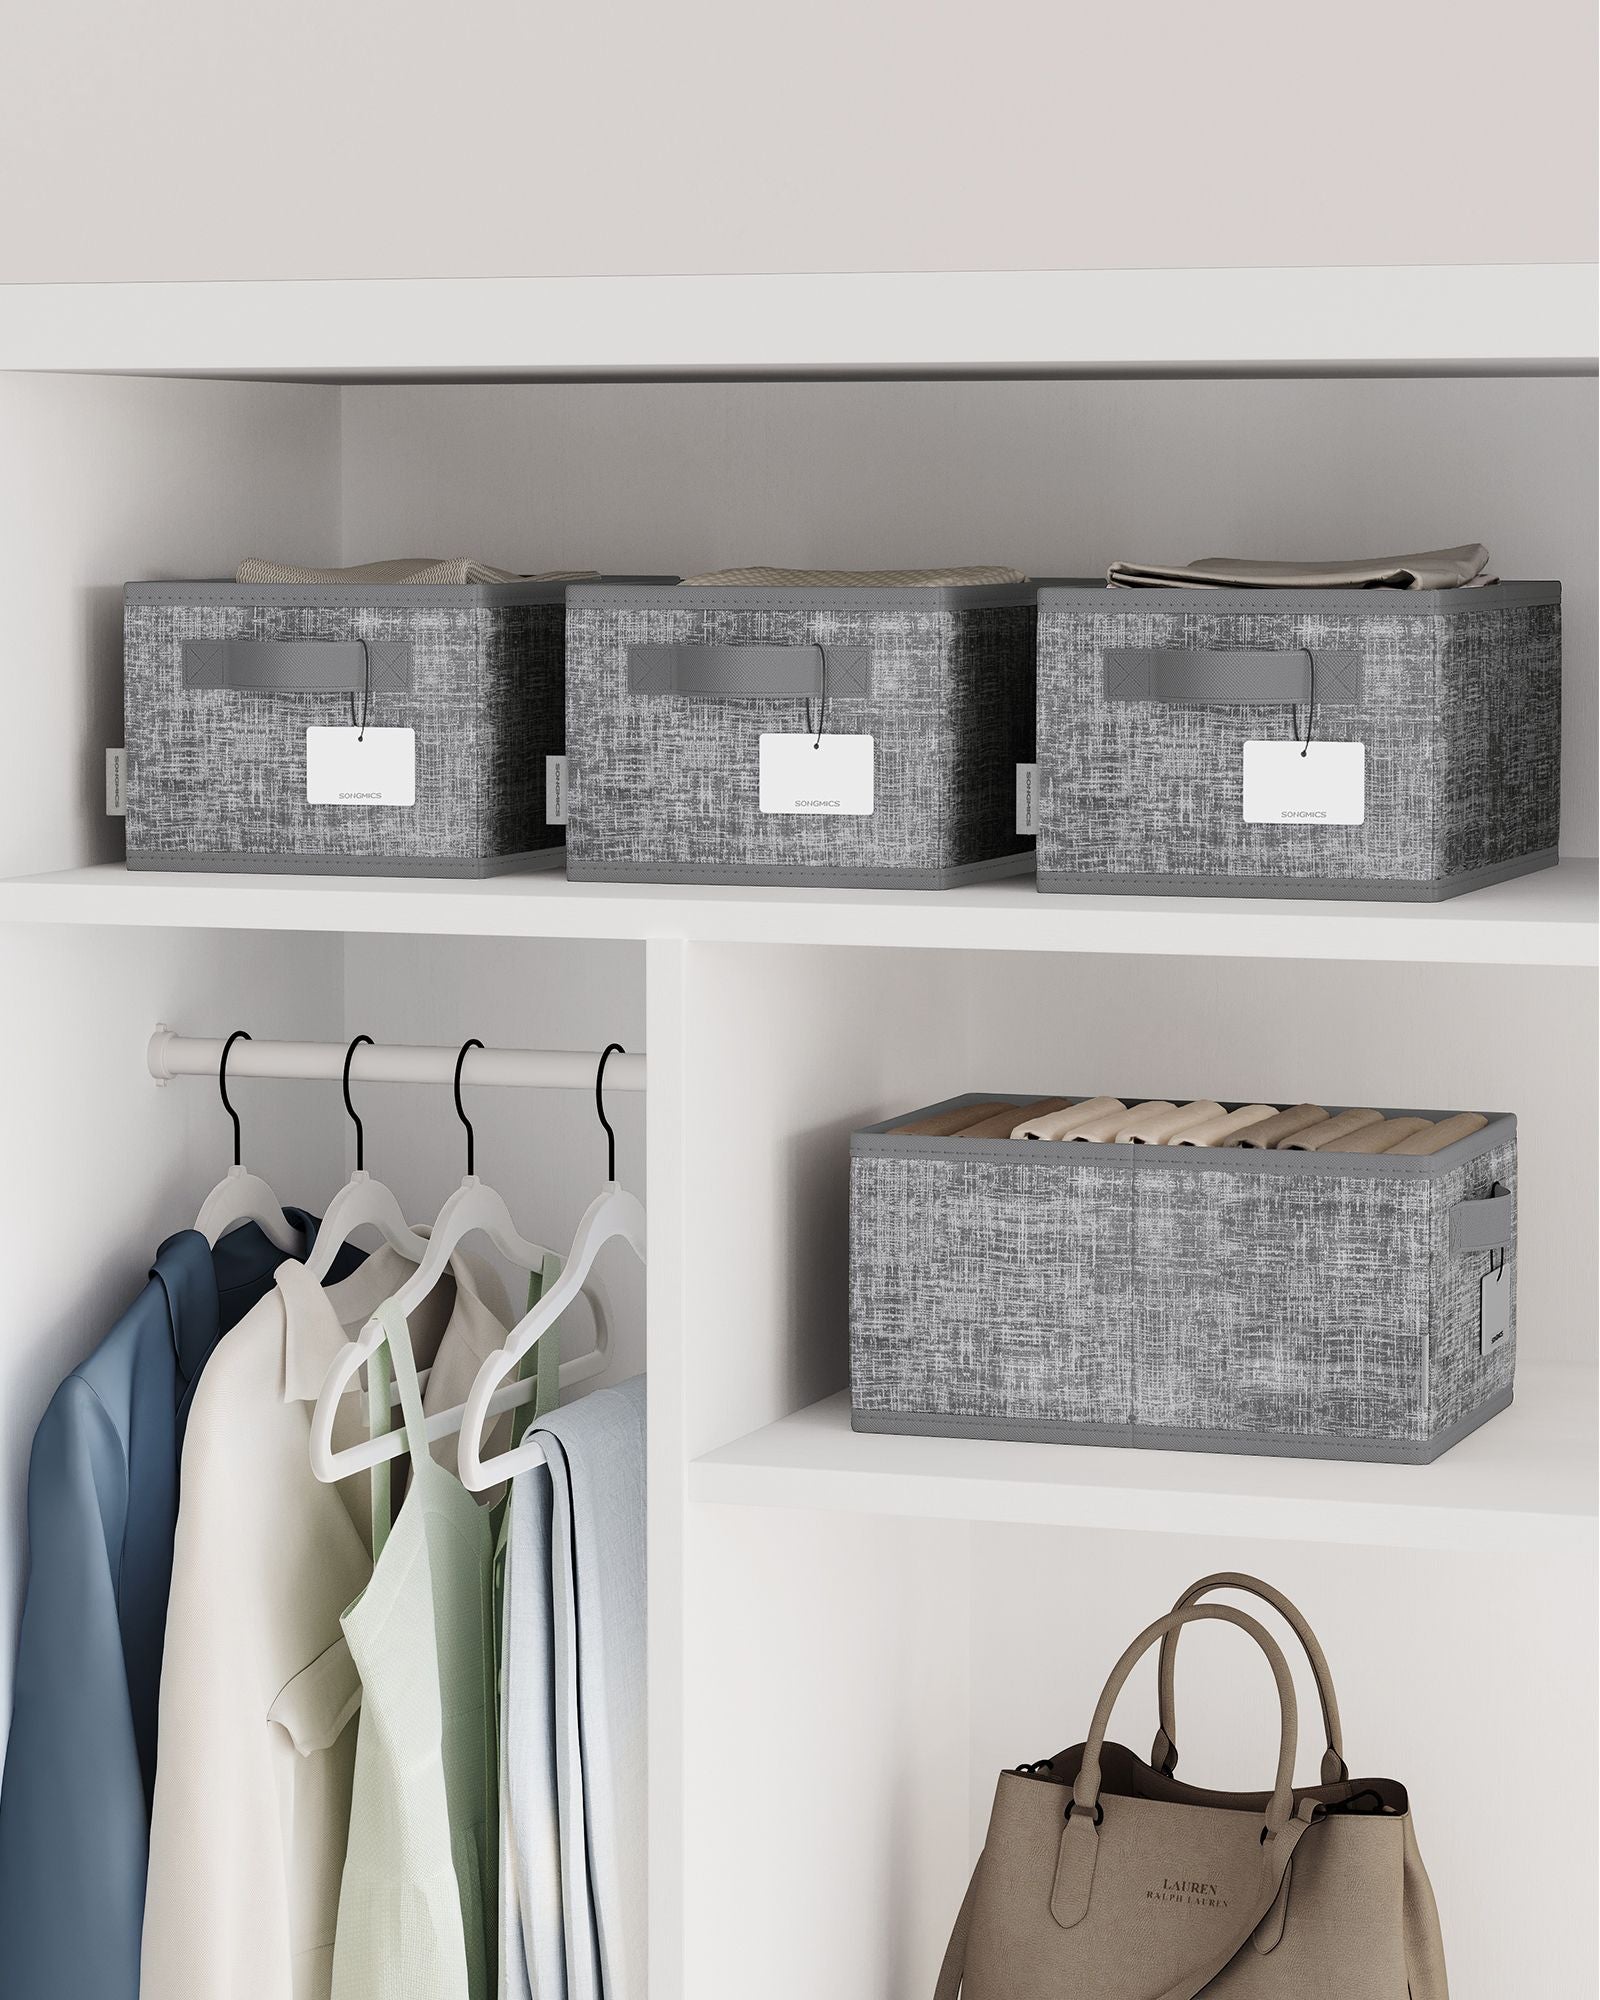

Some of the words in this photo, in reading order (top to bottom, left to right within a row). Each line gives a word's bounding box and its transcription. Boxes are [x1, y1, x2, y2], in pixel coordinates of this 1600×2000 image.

[338, 792, 383, 800] SONGMICS
[794, 800, 841, 808] SONGMICS
[1280, 810, 1328, 819] SONGMICS
[1163, 1878, 1219, 1896] LAUREN
[1146, 1890, 1183, 1903] RALPH
